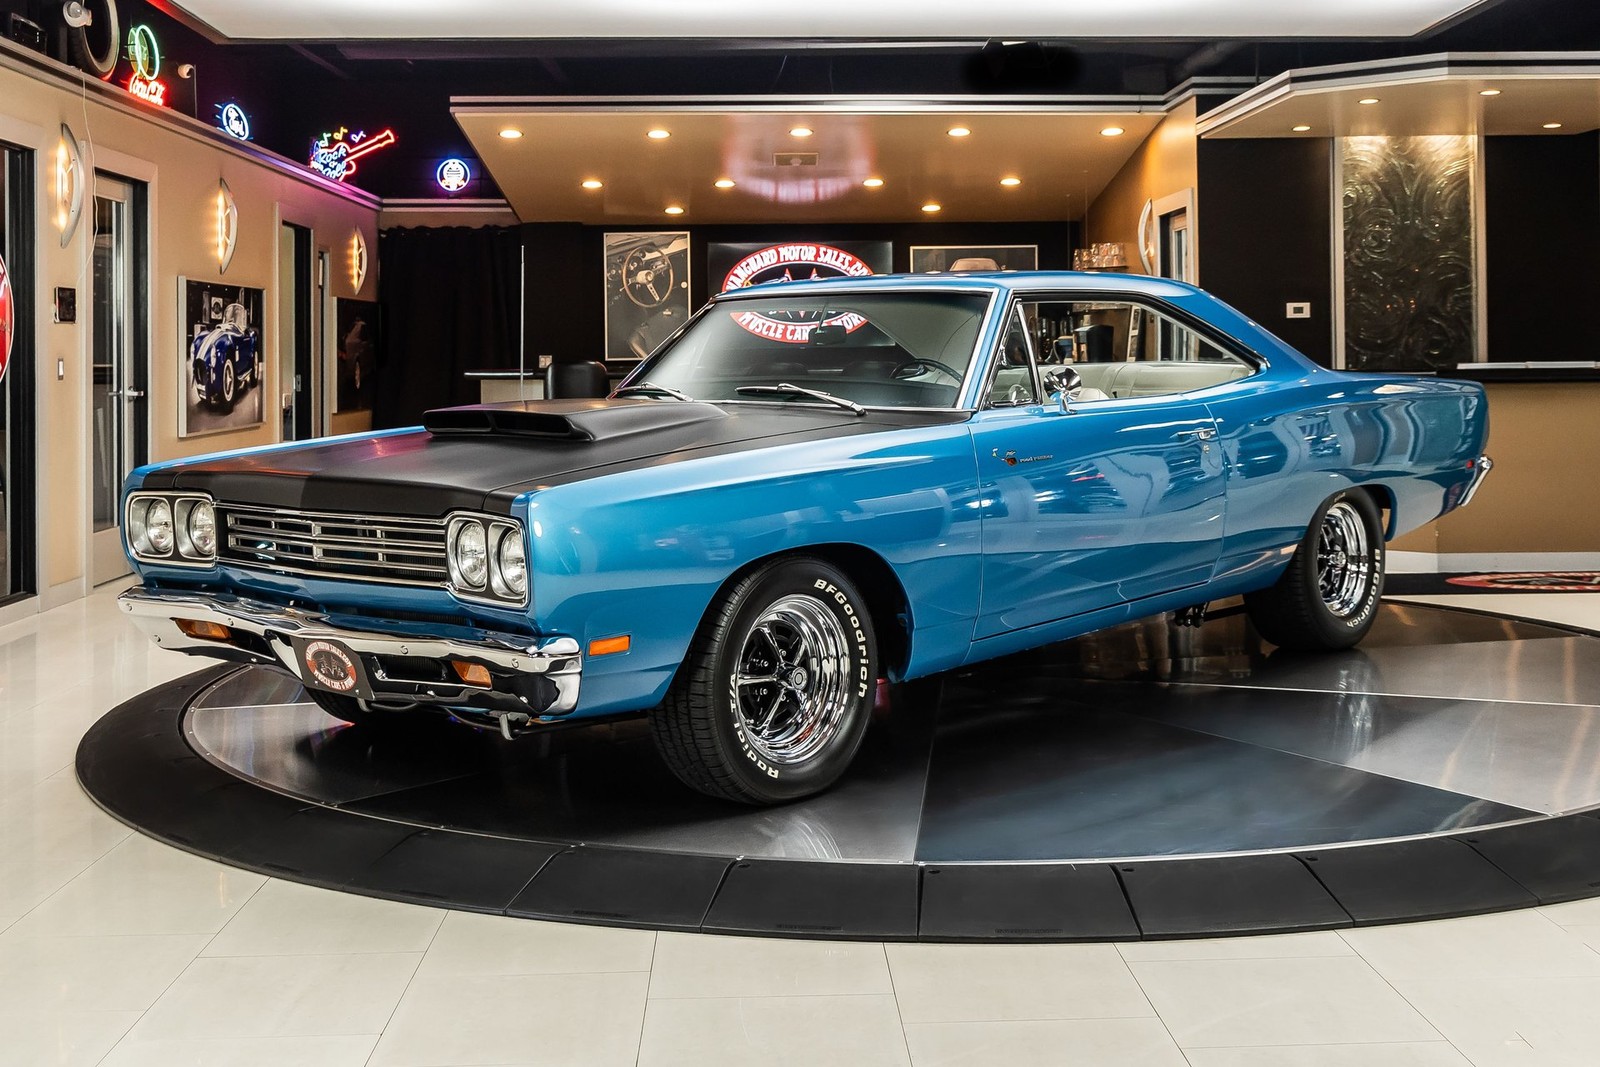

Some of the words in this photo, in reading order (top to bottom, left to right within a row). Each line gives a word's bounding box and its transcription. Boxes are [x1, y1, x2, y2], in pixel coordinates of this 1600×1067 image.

[725, 248, 778, 291] VANGUARD
[777, 244, 816, 263] MOTOR
[816, 245, 871, 277] SALES.CO
[738, 311, 785, 339] MUSCLE
[1346, 548, 1381, 628] BFGoodrich
[813, 578, 869, 698] BFGoodrich
[733, 722, 780, 779] Radial
